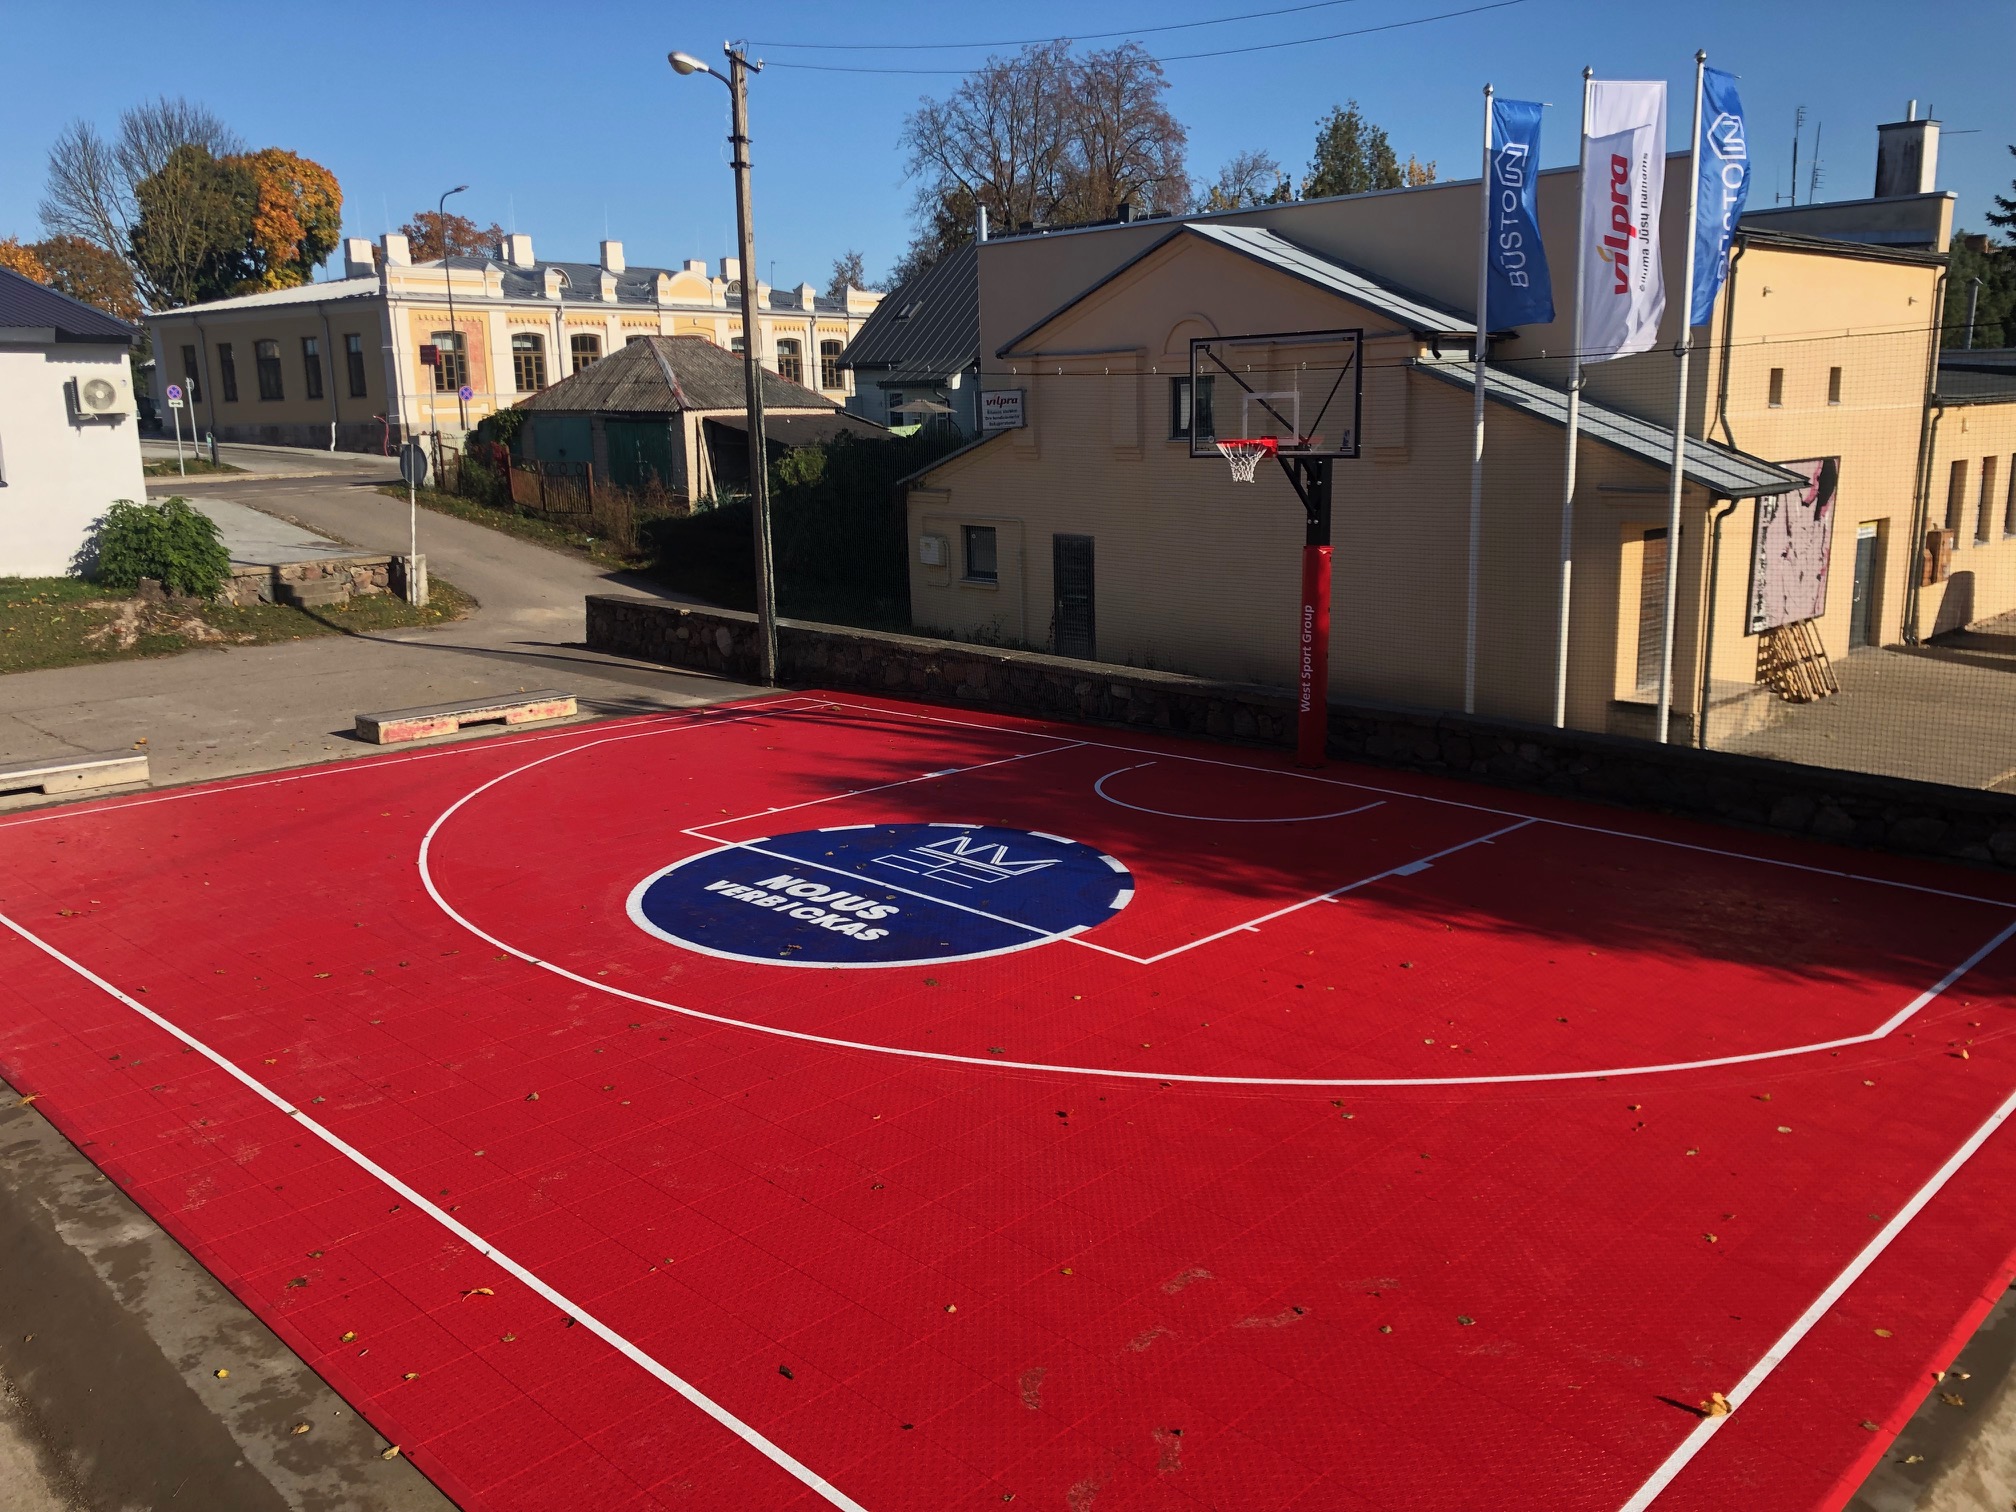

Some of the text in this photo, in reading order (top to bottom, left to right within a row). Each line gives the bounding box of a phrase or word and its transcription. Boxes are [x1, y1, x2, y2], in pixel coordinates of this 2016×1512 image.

[1600, 153, 1637, 295] vilpra
[986, 395, 1018, 408] vilpra
[1301, 605, 1314, 713] West Sport Group
[703, 879, 890, 941] VERBICKAS
[753, 874, 900, 920] NOJUS
